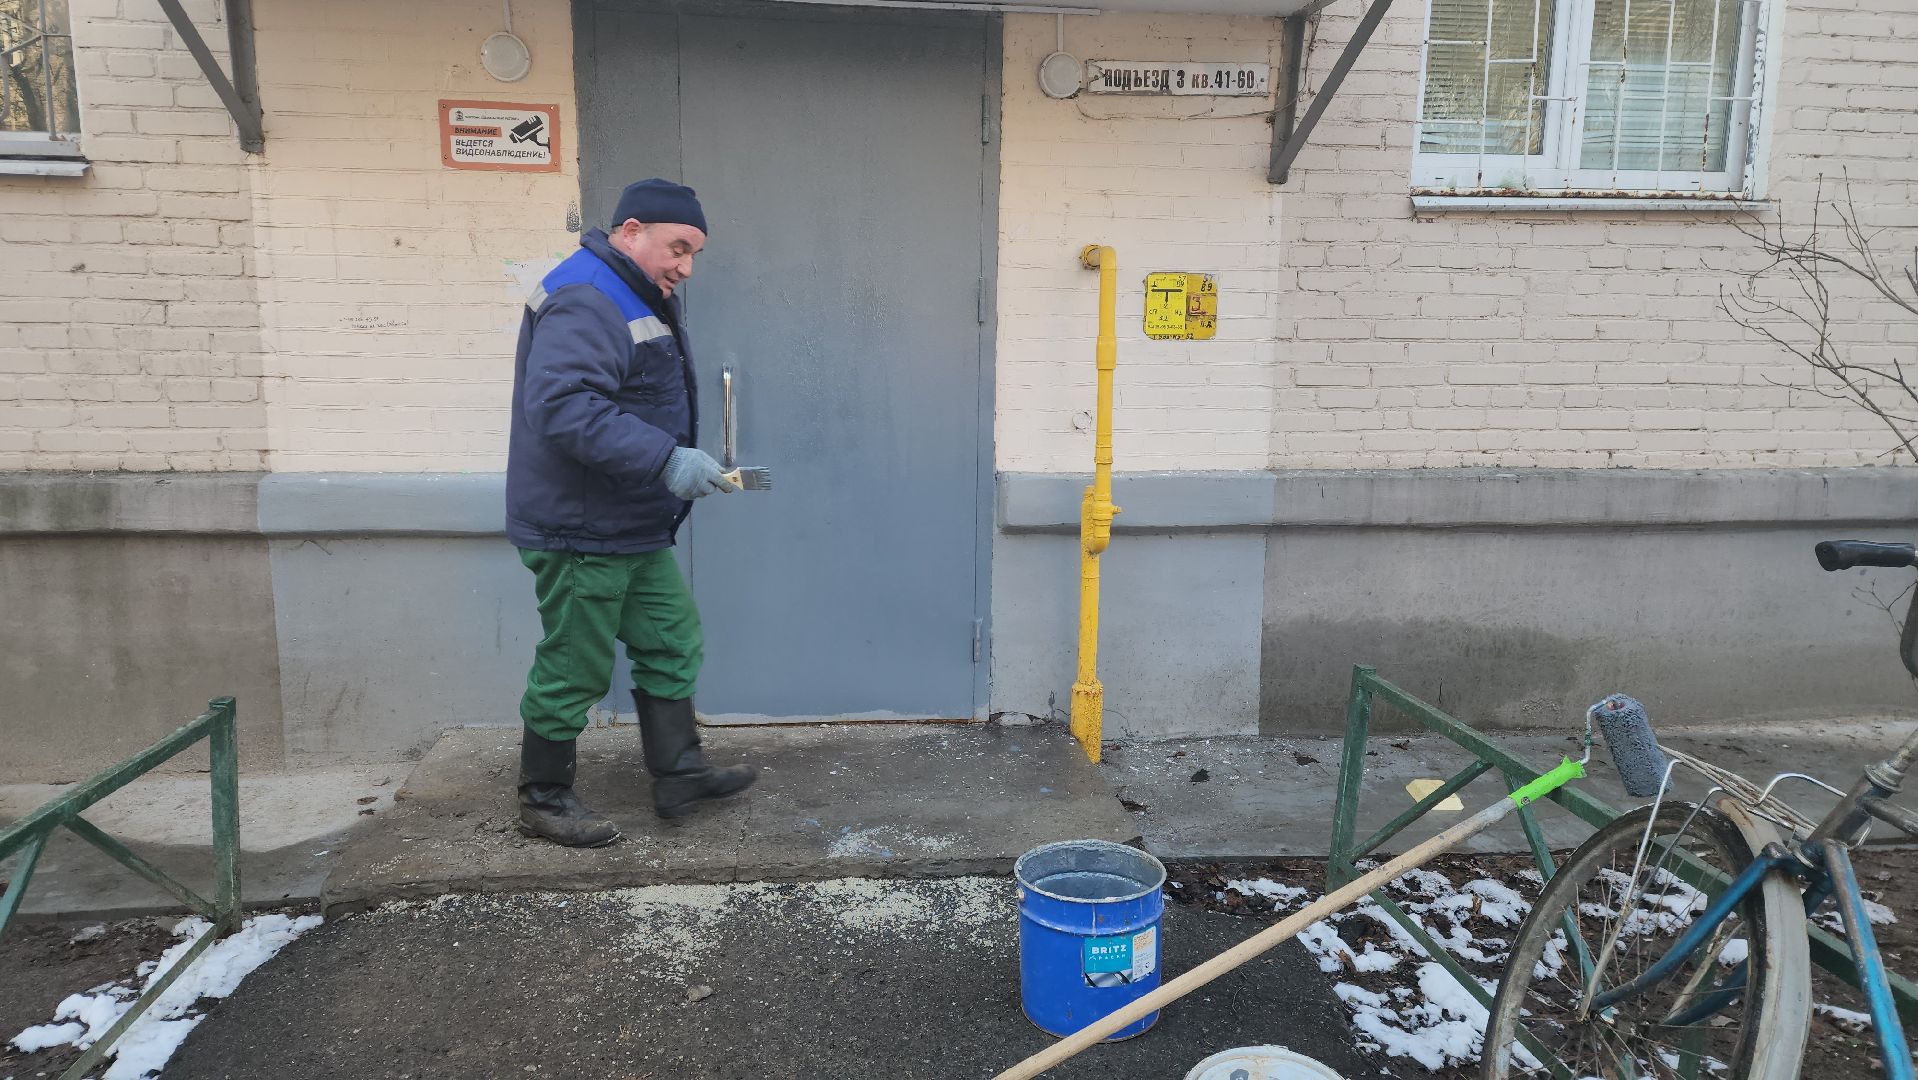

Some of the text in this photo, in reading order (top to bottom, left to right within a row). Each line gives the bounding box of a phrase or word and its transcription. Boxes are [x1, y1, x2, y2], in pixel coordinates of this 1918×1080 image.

[1104, 69, 1170, 90] ПОДЪЕЗД
[1176, 70, 1186, 89] 3
[455, 127, 498, 136] ВНИМАНИЕ
[455, 138, 494, 148] ВЕДЕТСЯ
[455, 147, 546, 159] ВИДЕОНАБЛЮДЕНИЕ!
[1091, 944, 1127, 955] BRITZ
